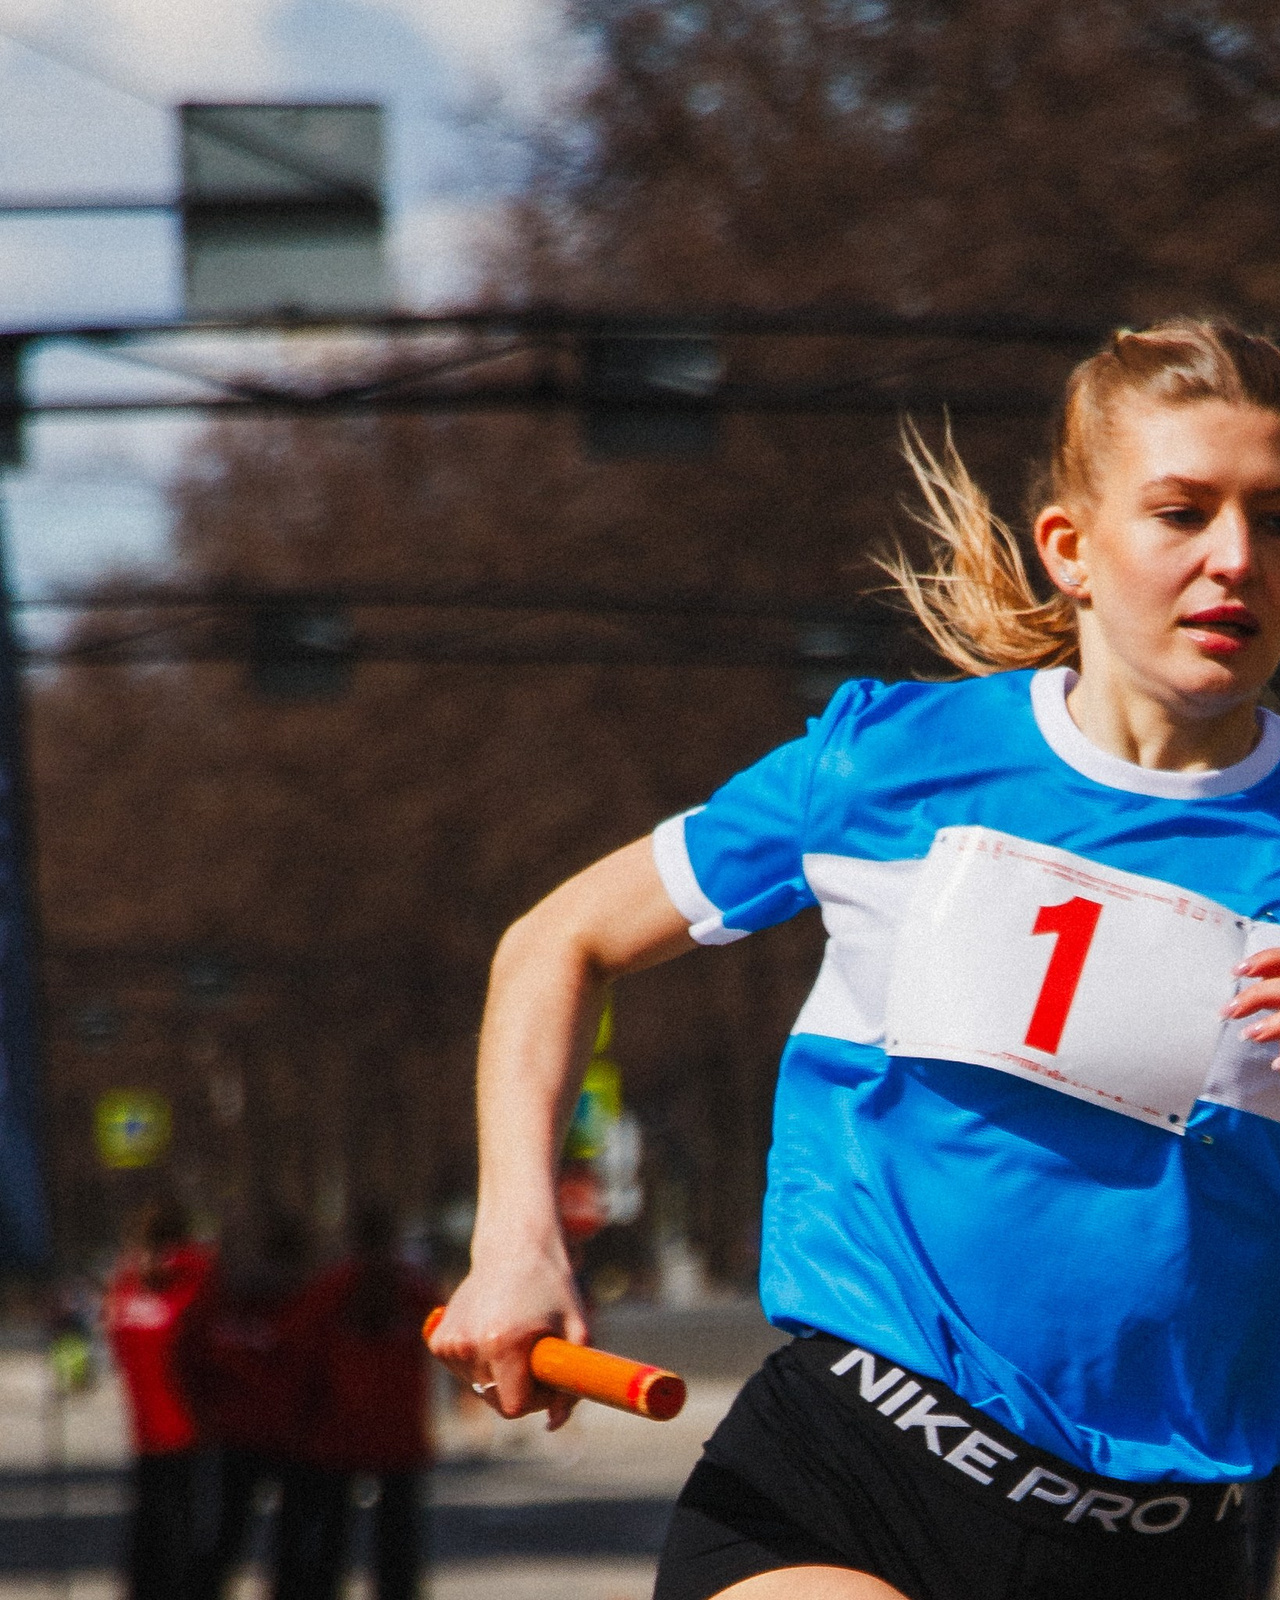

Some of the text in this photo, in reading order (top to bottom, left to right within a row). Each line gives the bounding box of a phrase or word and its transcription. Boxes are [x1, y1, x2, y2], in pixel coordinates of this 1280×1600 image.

[1023, 895, 1104, 1056] 1
[830, 1348, 1017, 1485] NIKE
[1006, 1466, 1190, 1535] PRO
